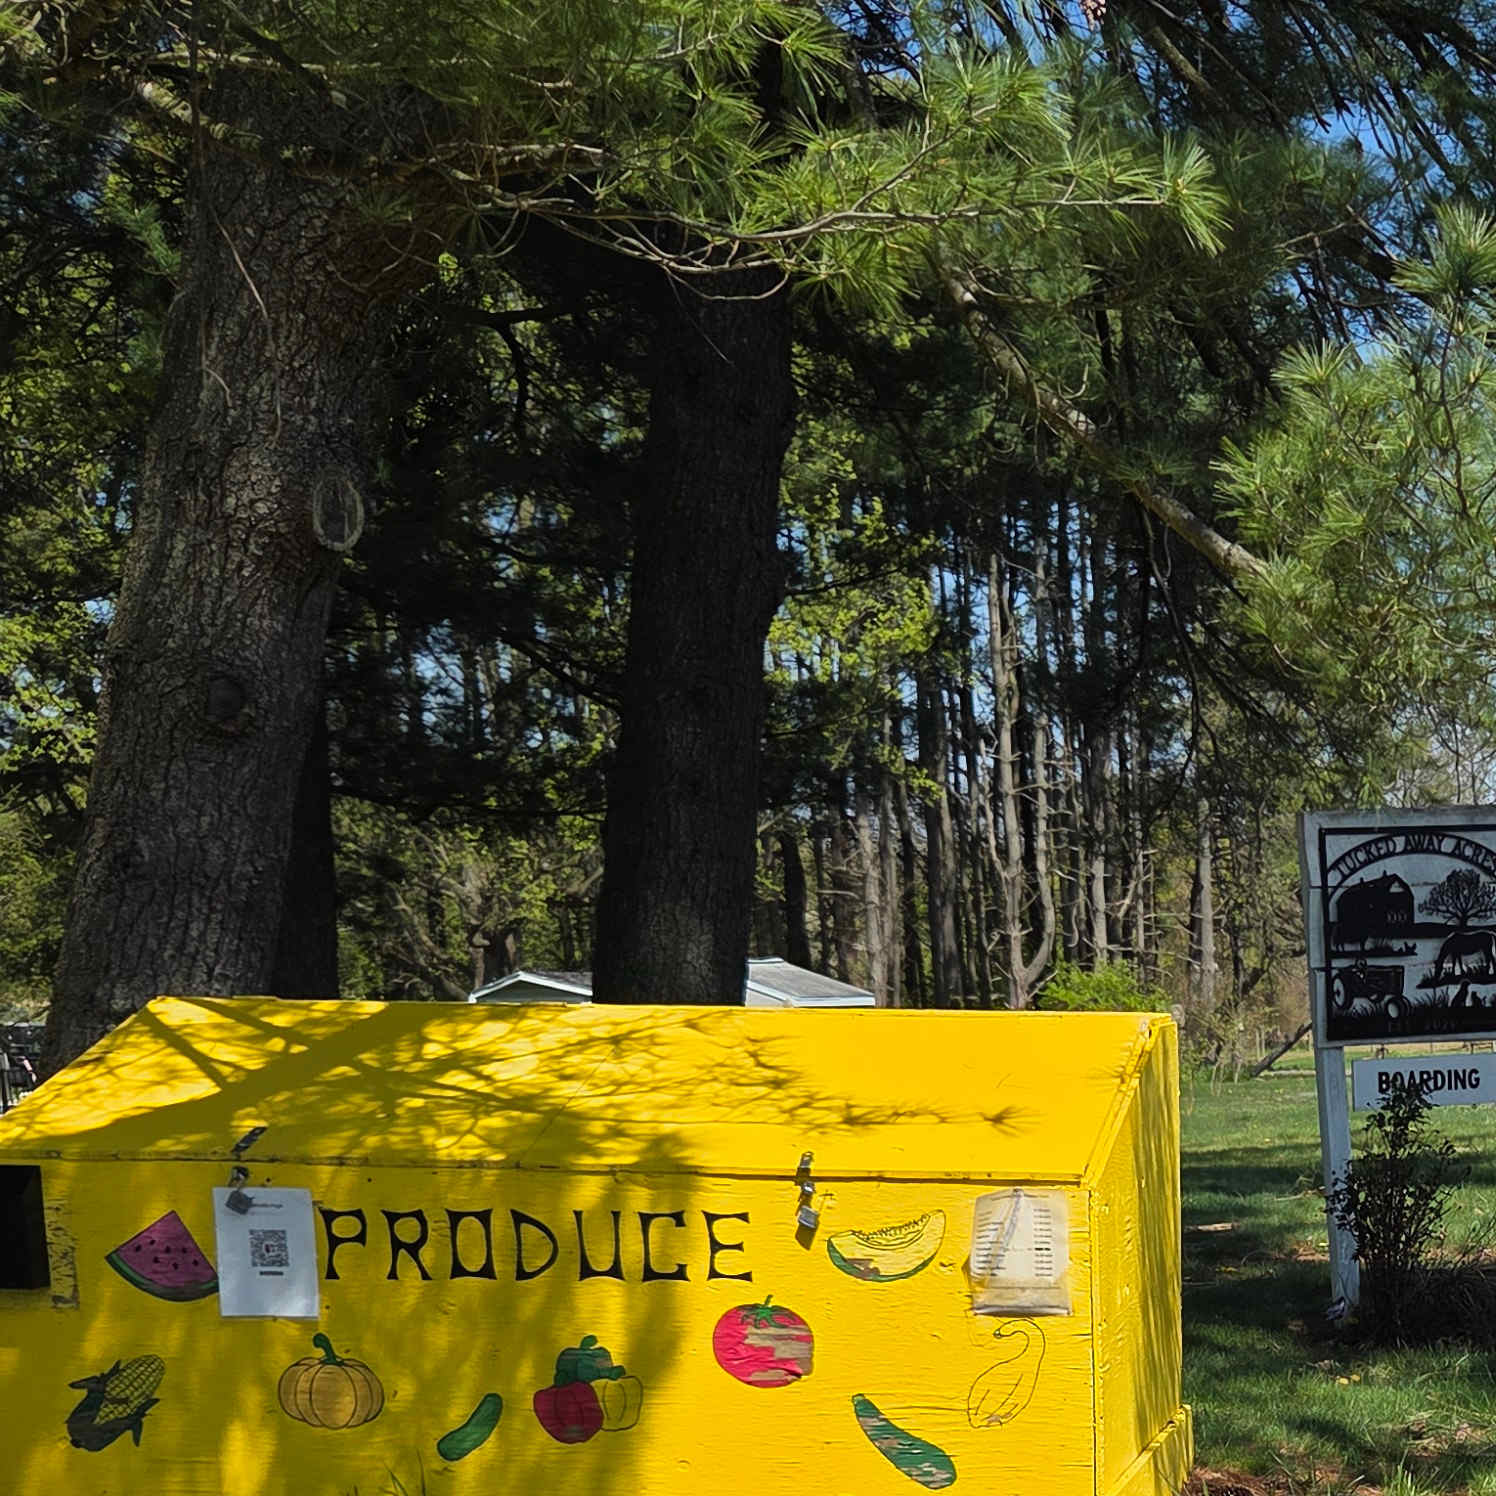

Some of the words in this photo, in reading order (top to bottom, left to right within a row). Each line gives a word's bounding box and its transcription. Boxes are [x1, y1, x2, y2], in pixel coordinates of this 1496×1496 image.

[1335, 837, 1397, 878] TUCKED
[1404, 834, 1444, 853] AWAY
[1378, 1068, 1480, 1095] BOARDING
[319, 1208, 752, 1283] PRODUCE
